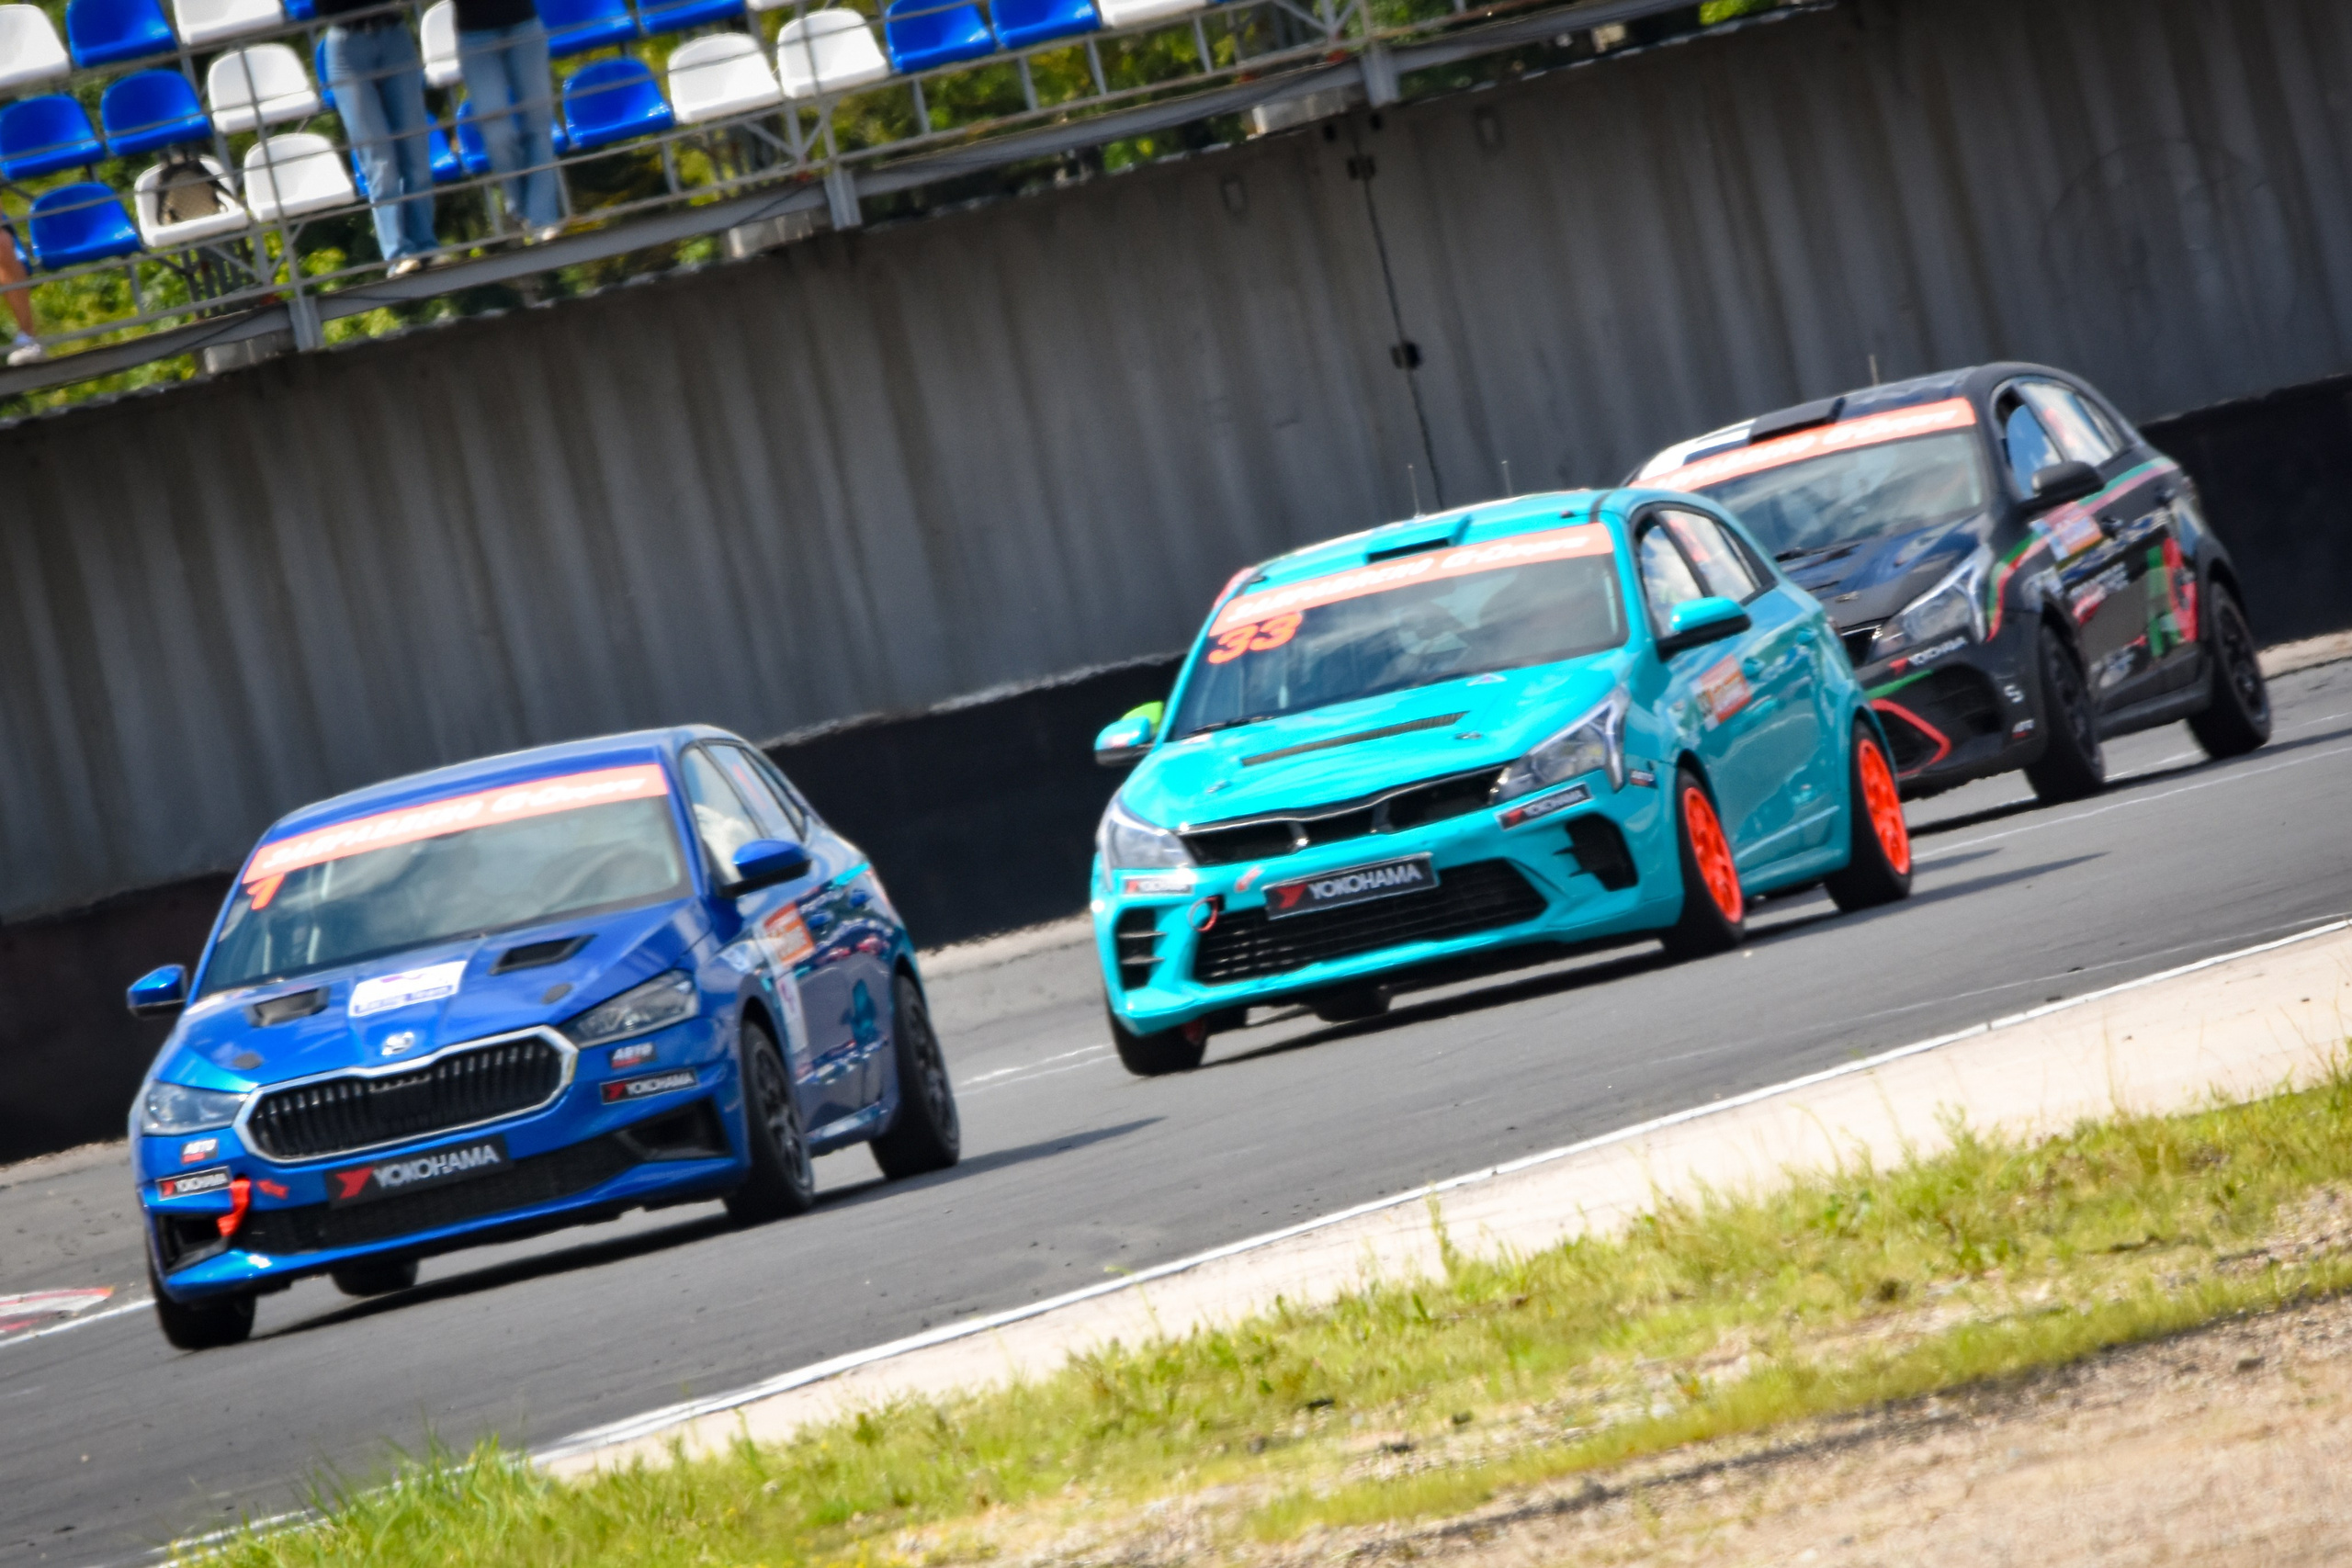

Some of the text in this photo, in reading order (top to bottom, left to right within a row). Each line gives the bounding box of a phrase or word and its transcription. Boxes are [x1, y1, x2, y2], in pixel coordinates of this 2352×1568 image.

[1208, 611, 1303, 664] 33
[245, 872, 286, 912] 1
[1307, 863, 1423, 901] YOKOHAMA
[372, 1144, 502, 1190] YOKOHAMA
